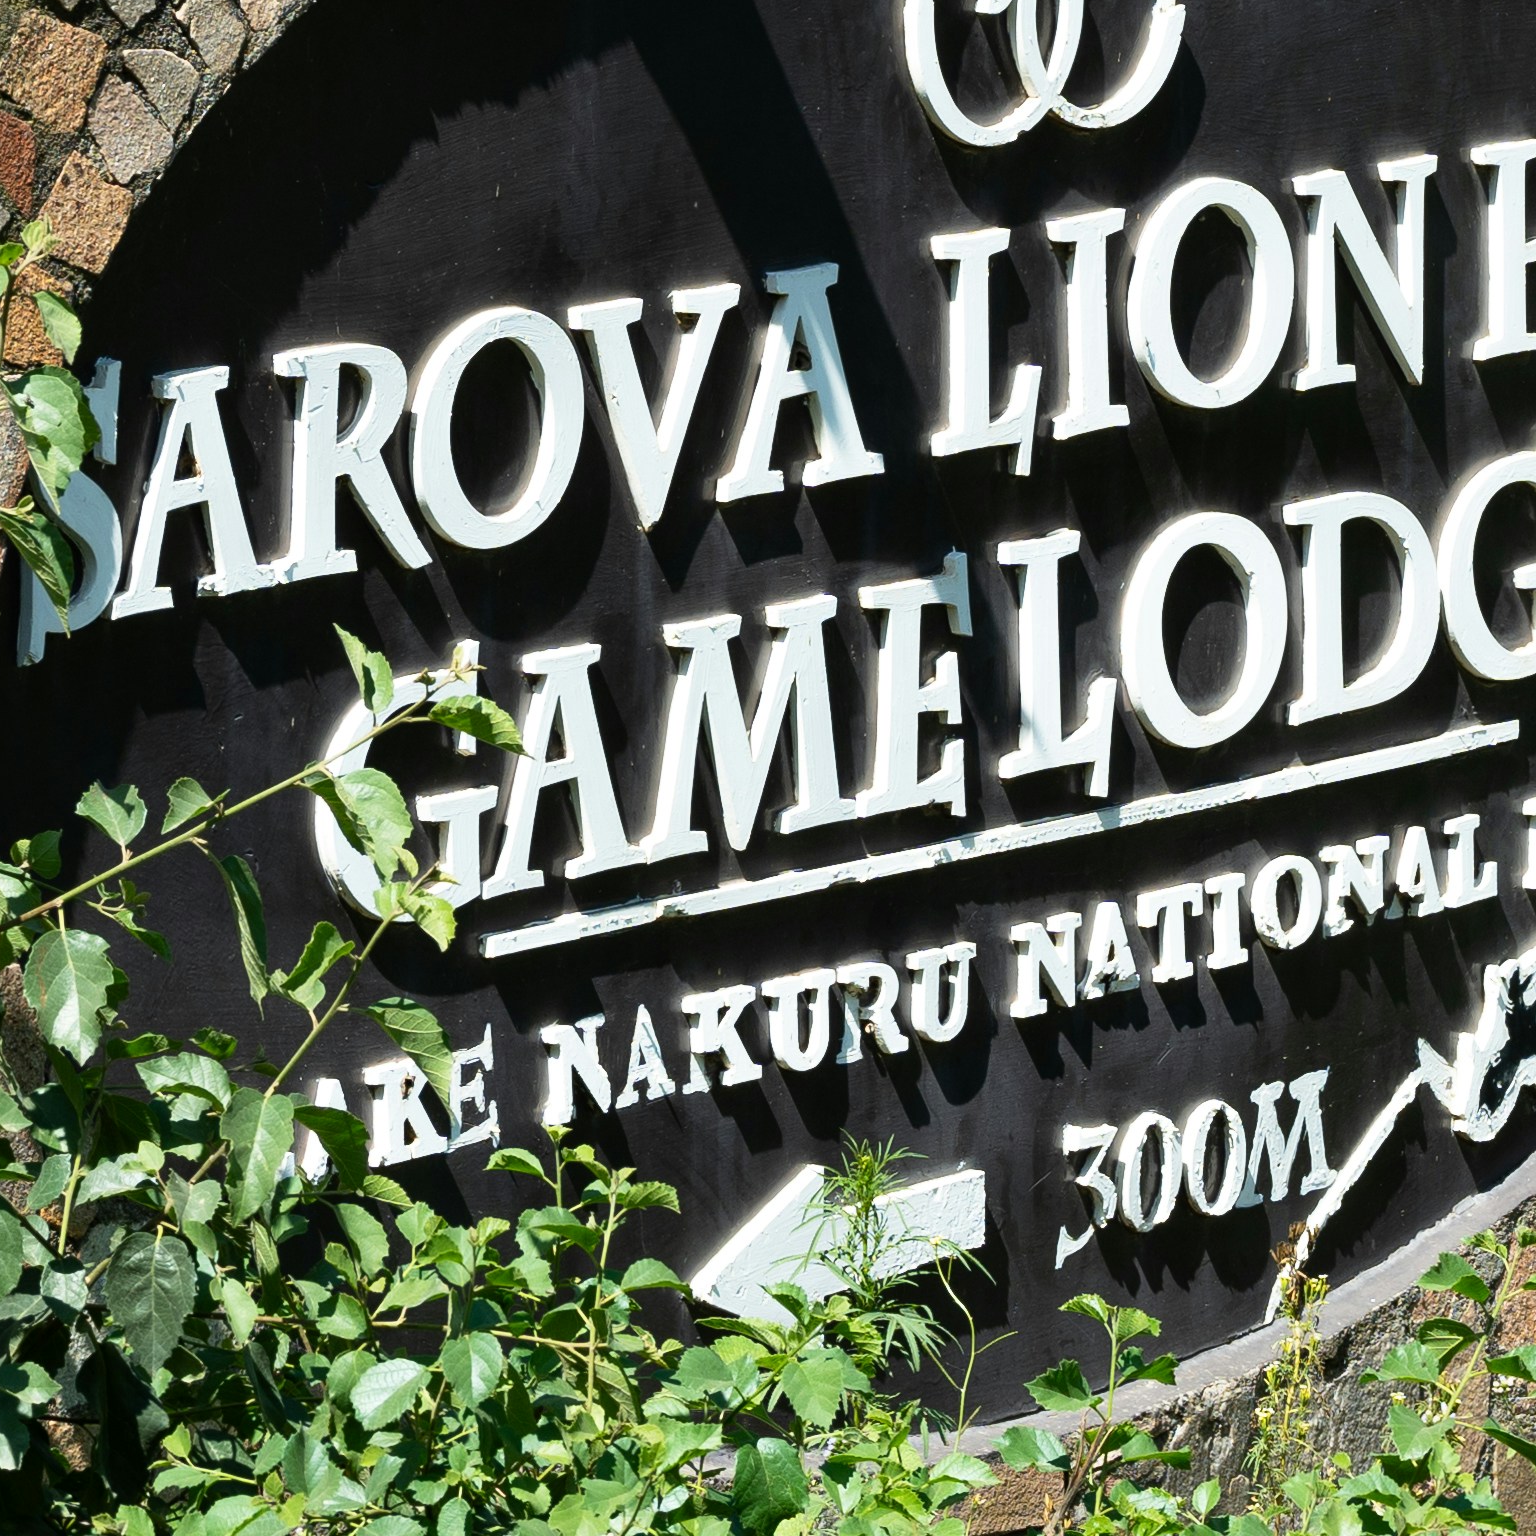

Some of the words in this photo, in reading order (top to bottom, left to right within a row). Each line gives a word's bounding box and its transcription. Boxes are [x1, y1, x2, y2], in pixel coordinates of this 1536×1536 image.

[16, 262, 885, 666] SAROVA
[930, 150, 1439, 476] LION
[314, 548, 973, 924] GAME
[276, 1023, 500, 1182] AKE
[541, 940, 977, 1126] NAKURU
[1009, 812, 1498, 1020] NATIONAL
[1055, 1066, 1339, 1270] 300M
